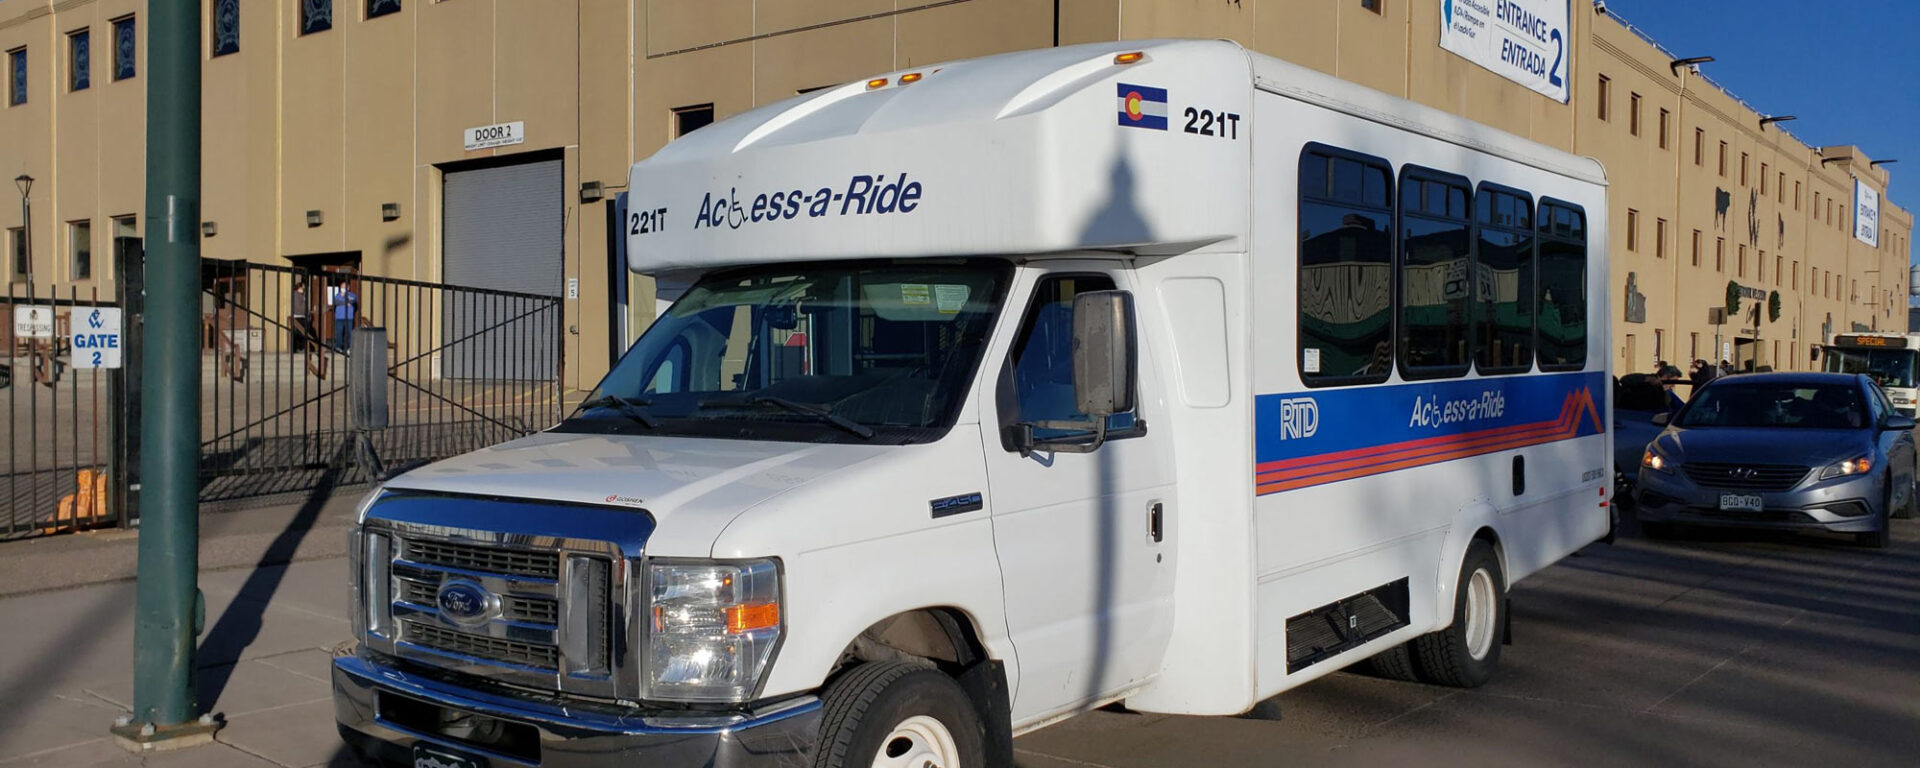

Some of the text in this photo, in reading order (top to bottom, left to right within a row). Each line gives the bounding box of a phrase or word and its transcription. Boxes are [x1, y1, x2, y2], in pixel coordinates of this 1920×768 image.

[1496, 0, 1548, 44] ENTRANCE
[1501, 38, 1547, 80] ENTRADA
[1549, 28, 1563, 89] 2
[475, 125, 512, 141] DOOR 2
[1184, 106, 1241, 140] 221T
[630, 207, 668, 236] 221T
[74, 334, 119, 348] GATE
[1857, 335, 1886, 347] SPECIAL
[92, 351, 102, 366] 2
[1280, 396, 1319, 440] RTD
[446, 591, 473, 611] Ford
